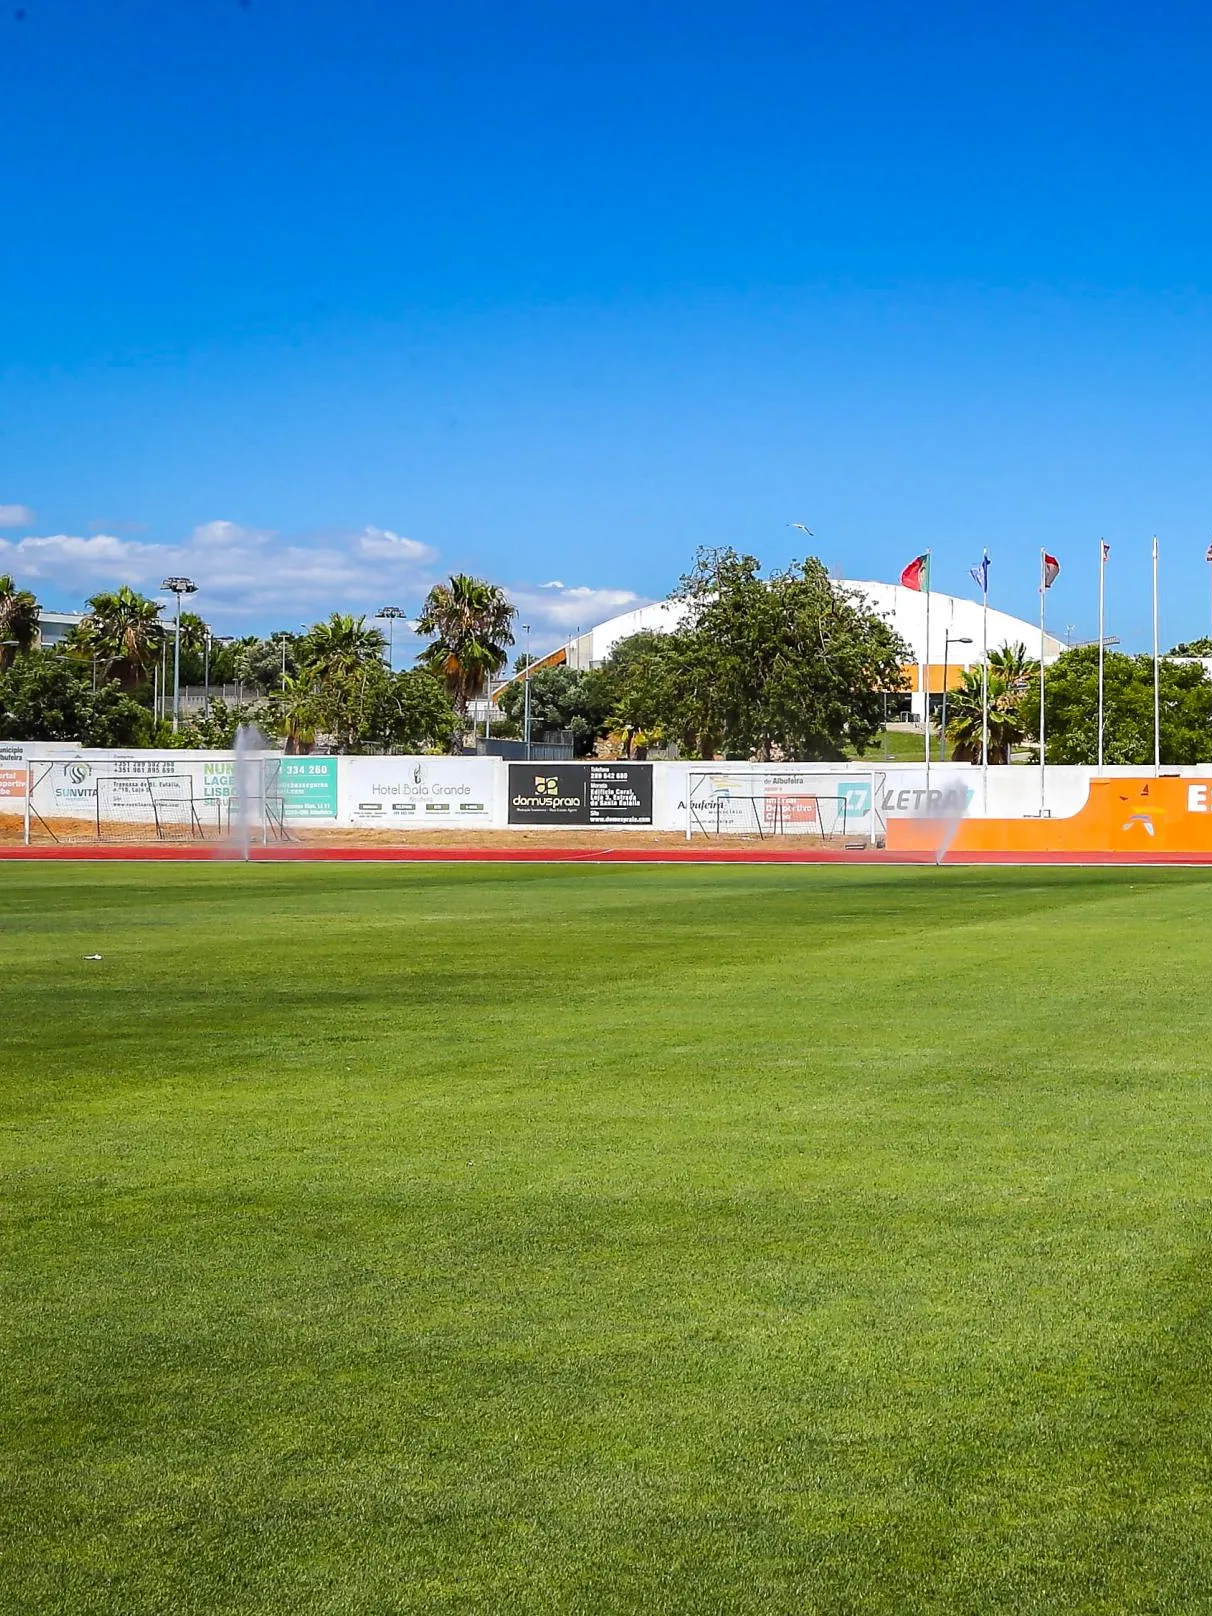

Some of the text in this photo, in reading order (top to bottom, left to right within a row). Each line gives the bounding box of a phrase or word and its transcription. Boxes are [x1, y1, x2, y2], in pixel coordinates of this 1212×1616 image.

[286, 766, 305, 774] 334
[308, 766, 328, 774] 260
[204, 776, 236, 785] LAGE
[56, 789, 97, 797] SUNVITA
[372, 784, 401, 795] Hotel
[432, 784, 471, 795] Grande
[513, 795, 580, 808] domuspraia
[677, 800, 724, 810] Abufeira
